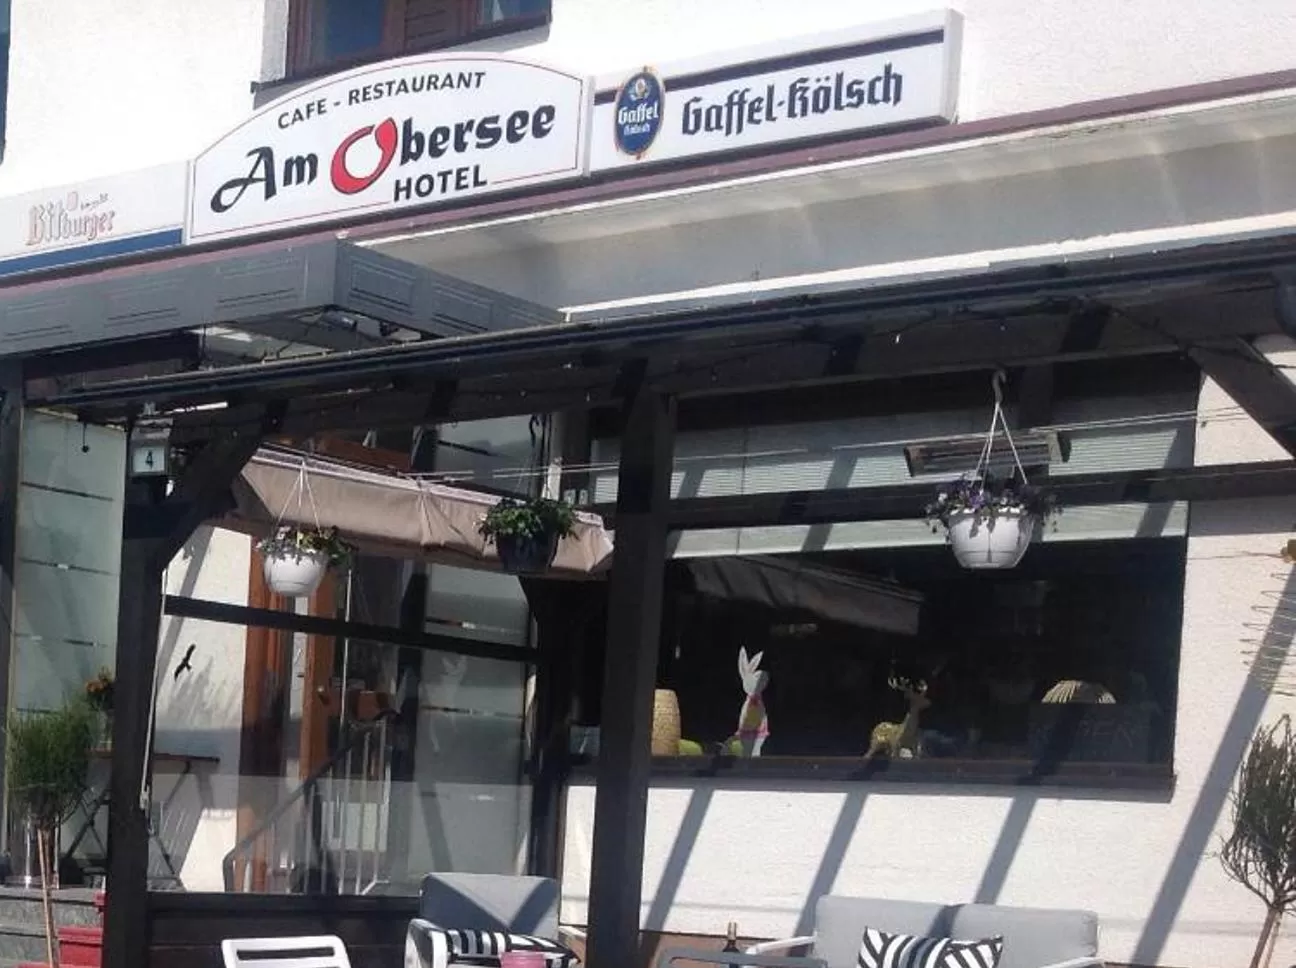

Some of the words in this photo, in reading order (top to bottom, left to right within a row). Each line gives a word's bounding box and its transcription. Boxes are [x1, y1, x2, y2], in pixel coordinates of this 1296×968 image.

[277, 98, 327, 130] CAFE
[348, 72, 486, 106] RESTAURANT
[618, 101, 659, 125] Gaffel
[682, 60, 903, 137] Gaffel-Kölsch
[210, 145, 319, 214] Am
[330, 104, 556, 195] Obersee
[393, 164, 488, 202] HOTEL
[25, 199, 115, 246] Bitburger
